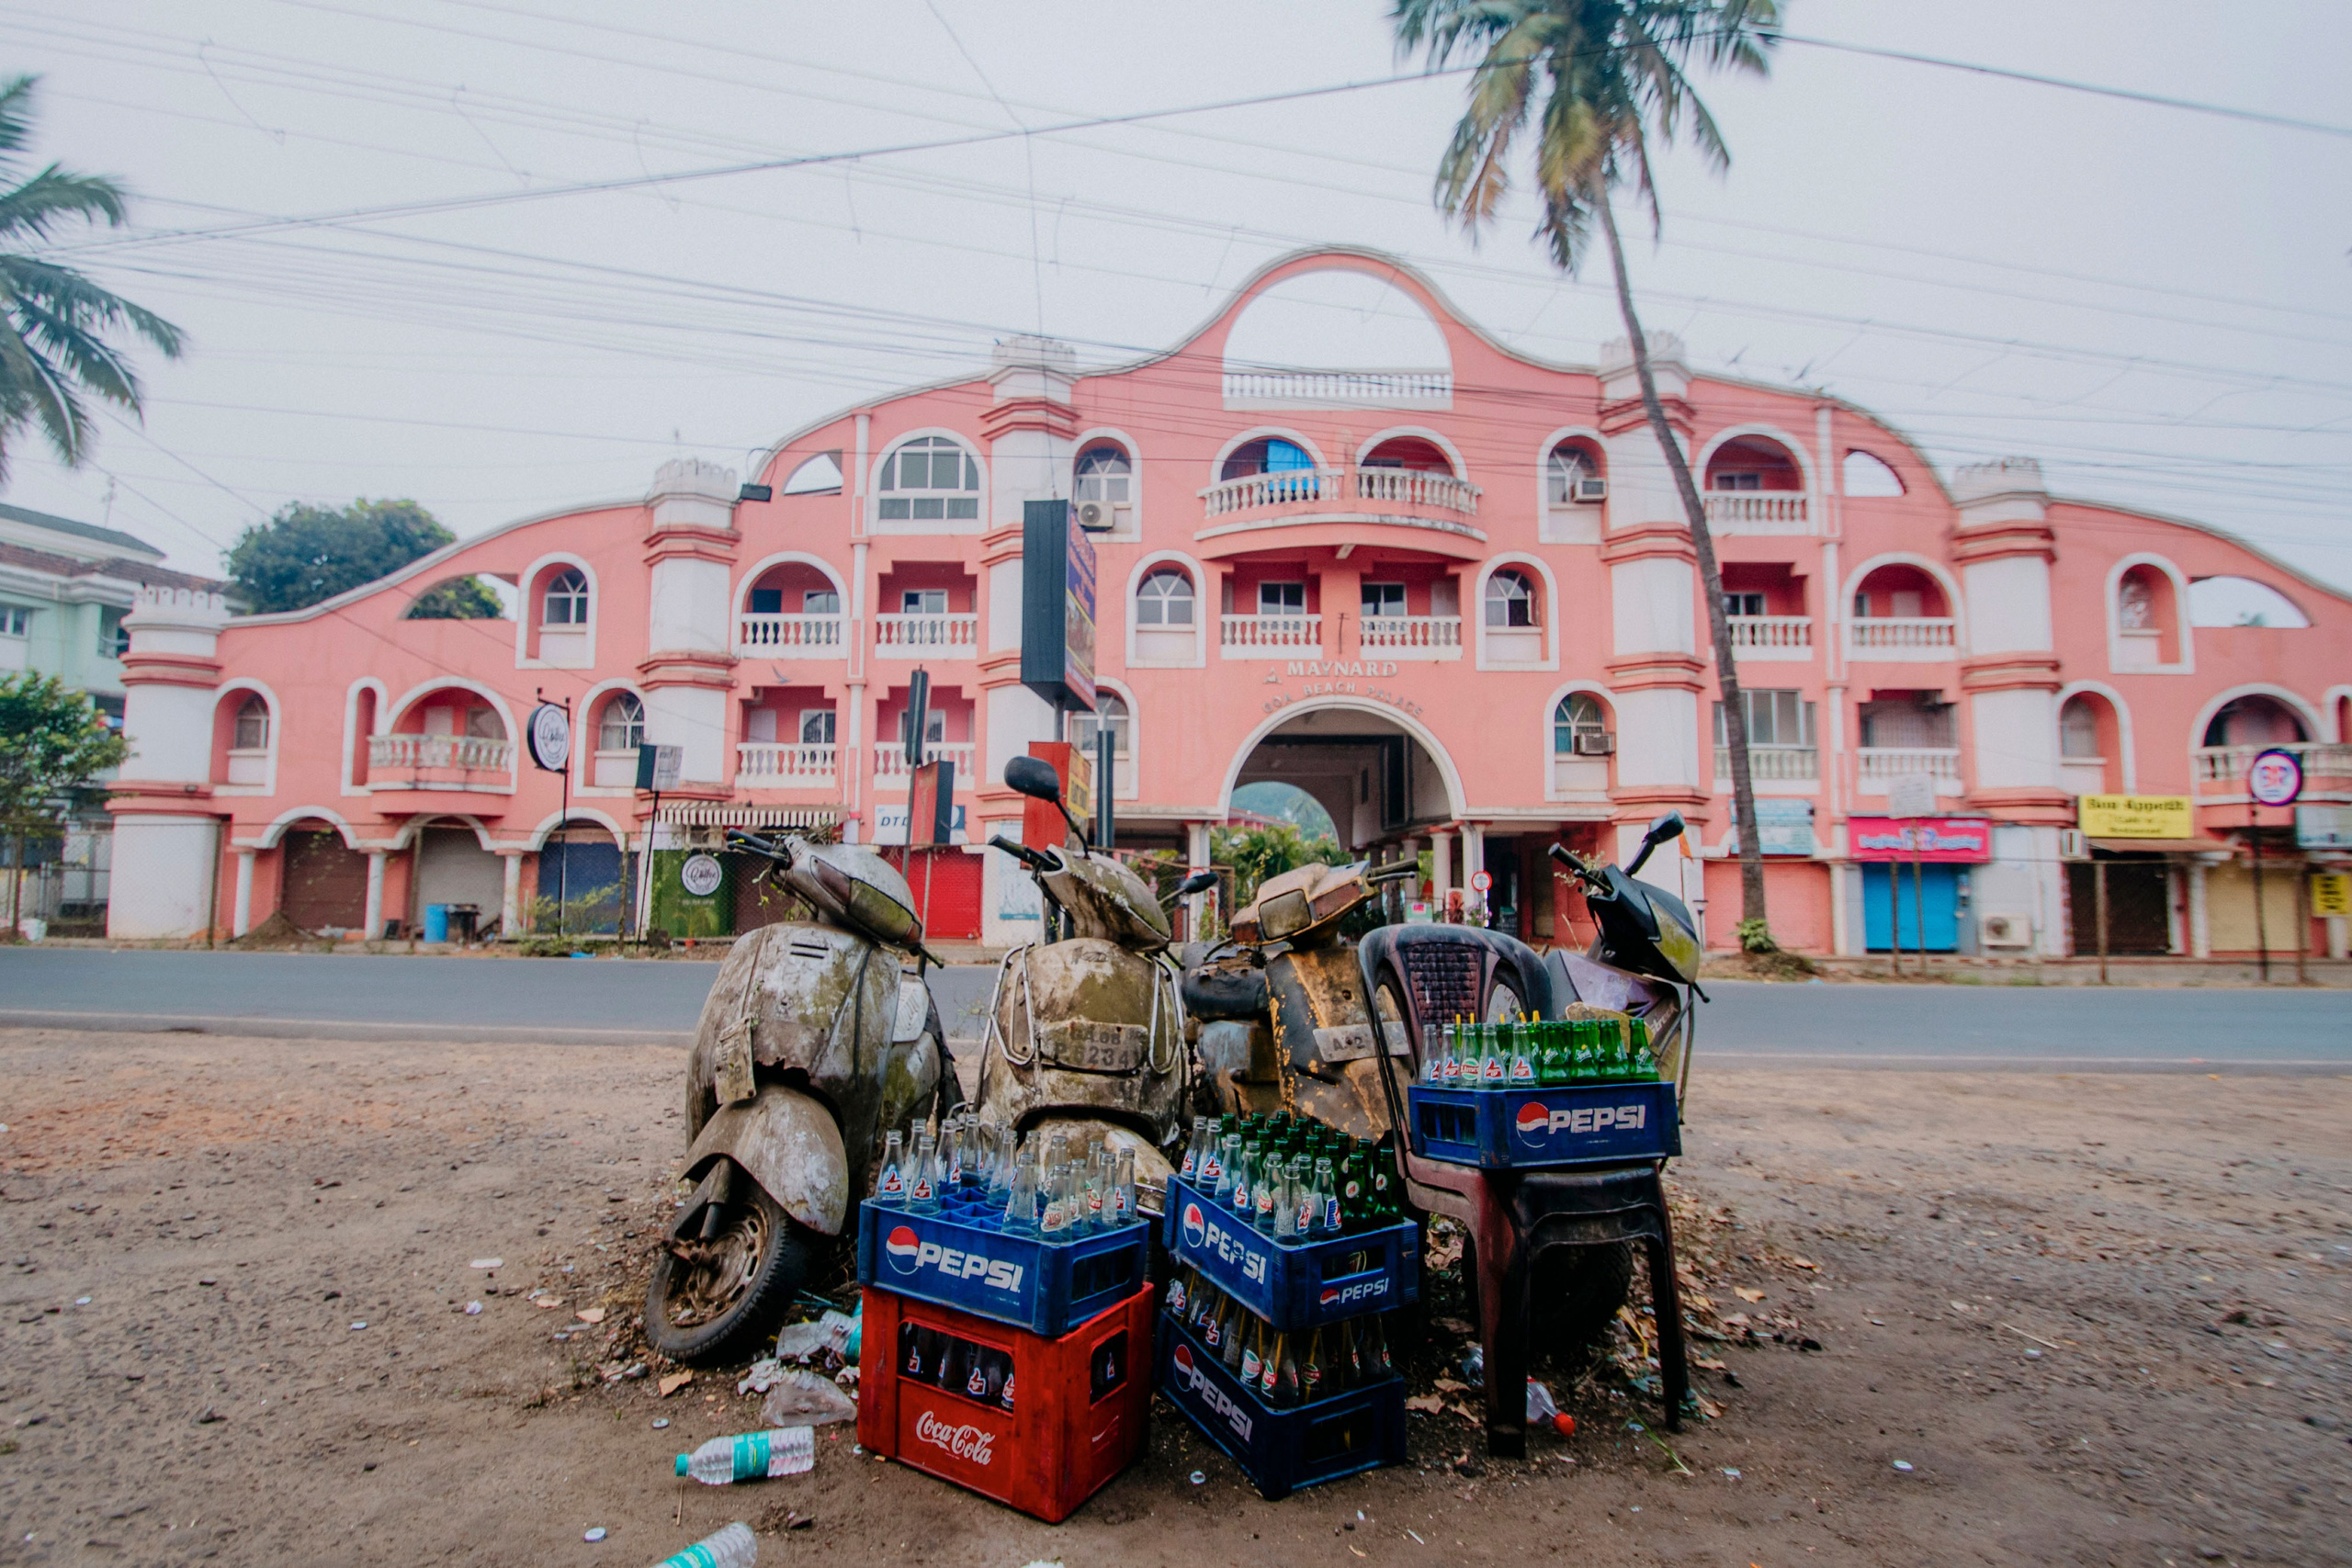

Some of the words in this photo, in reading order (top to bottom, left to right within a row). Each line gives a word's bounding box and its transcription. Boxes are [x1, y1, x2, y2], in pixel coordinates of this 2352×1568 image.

[1287, 660, 1397, 677] MAYNARD
[1262, 693, 1293, 714] GOA
[1303, 682, 1356, 696] BEACH
[1366, 685, 1423, 716] PALACE
[1548, 1104, 1645, 1134] PEPSI
[915, 1241, 1023, 1293] PEPSI
[1204, 1222, 1267, 1284] PEPSI
[1340, 1278, 1389, 1303] PEPSI
[1189, 1365, 1252, 1442] PEPSI
[916, 1410, 996, 1466] Coca-Cola
